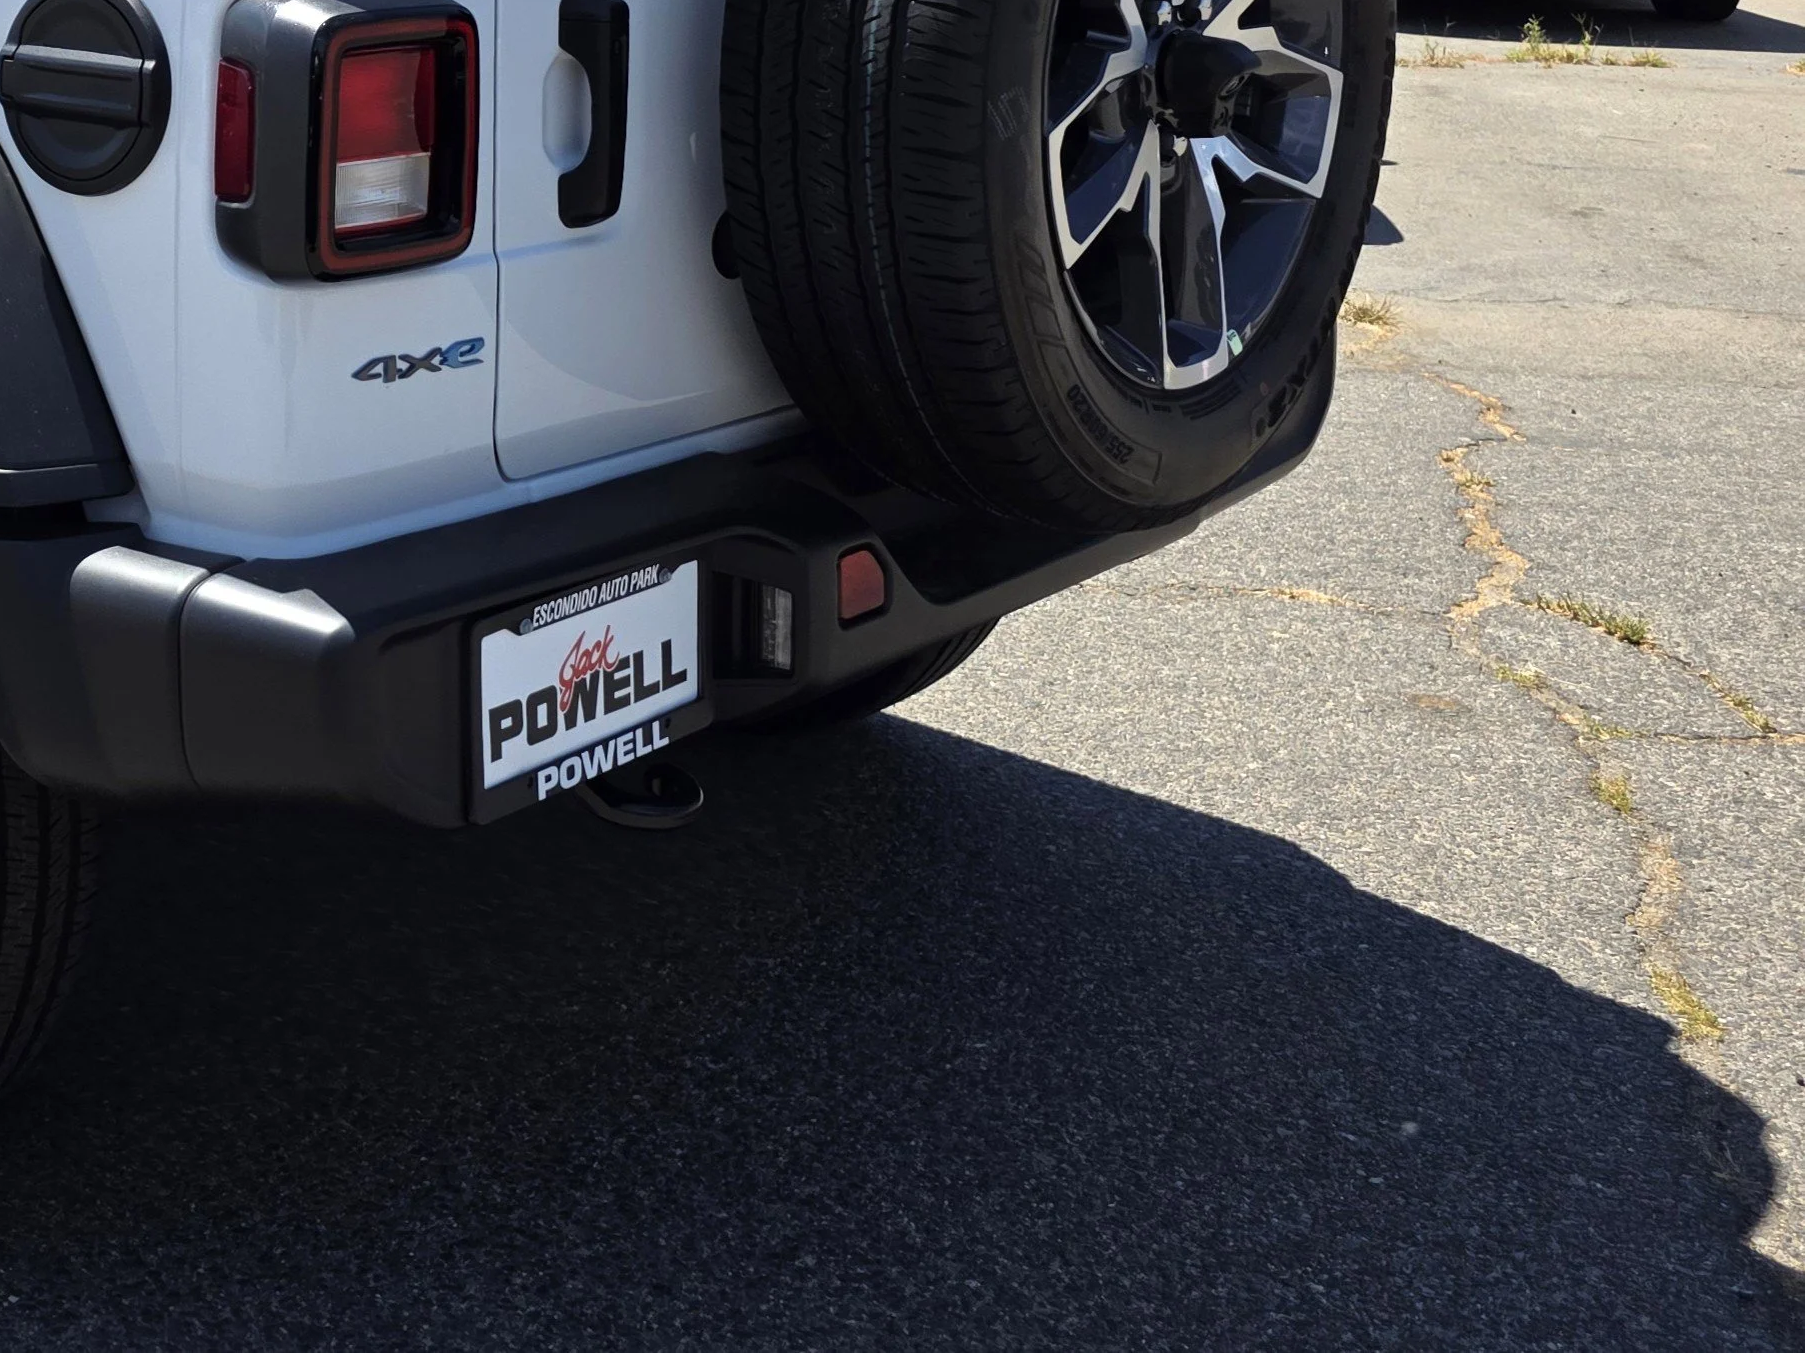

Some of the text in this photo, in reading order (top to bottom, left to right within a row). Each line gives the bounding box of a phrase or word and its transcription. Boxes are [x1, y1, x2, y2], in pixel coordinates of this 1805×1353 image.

[532, 564, 659, 627] ESCONDIDO AUTO PARK
[488, 638, 688, 763] POWELL
[559, 624, 619, 713] Jack
[537, 720, 670, 801] POWELL
